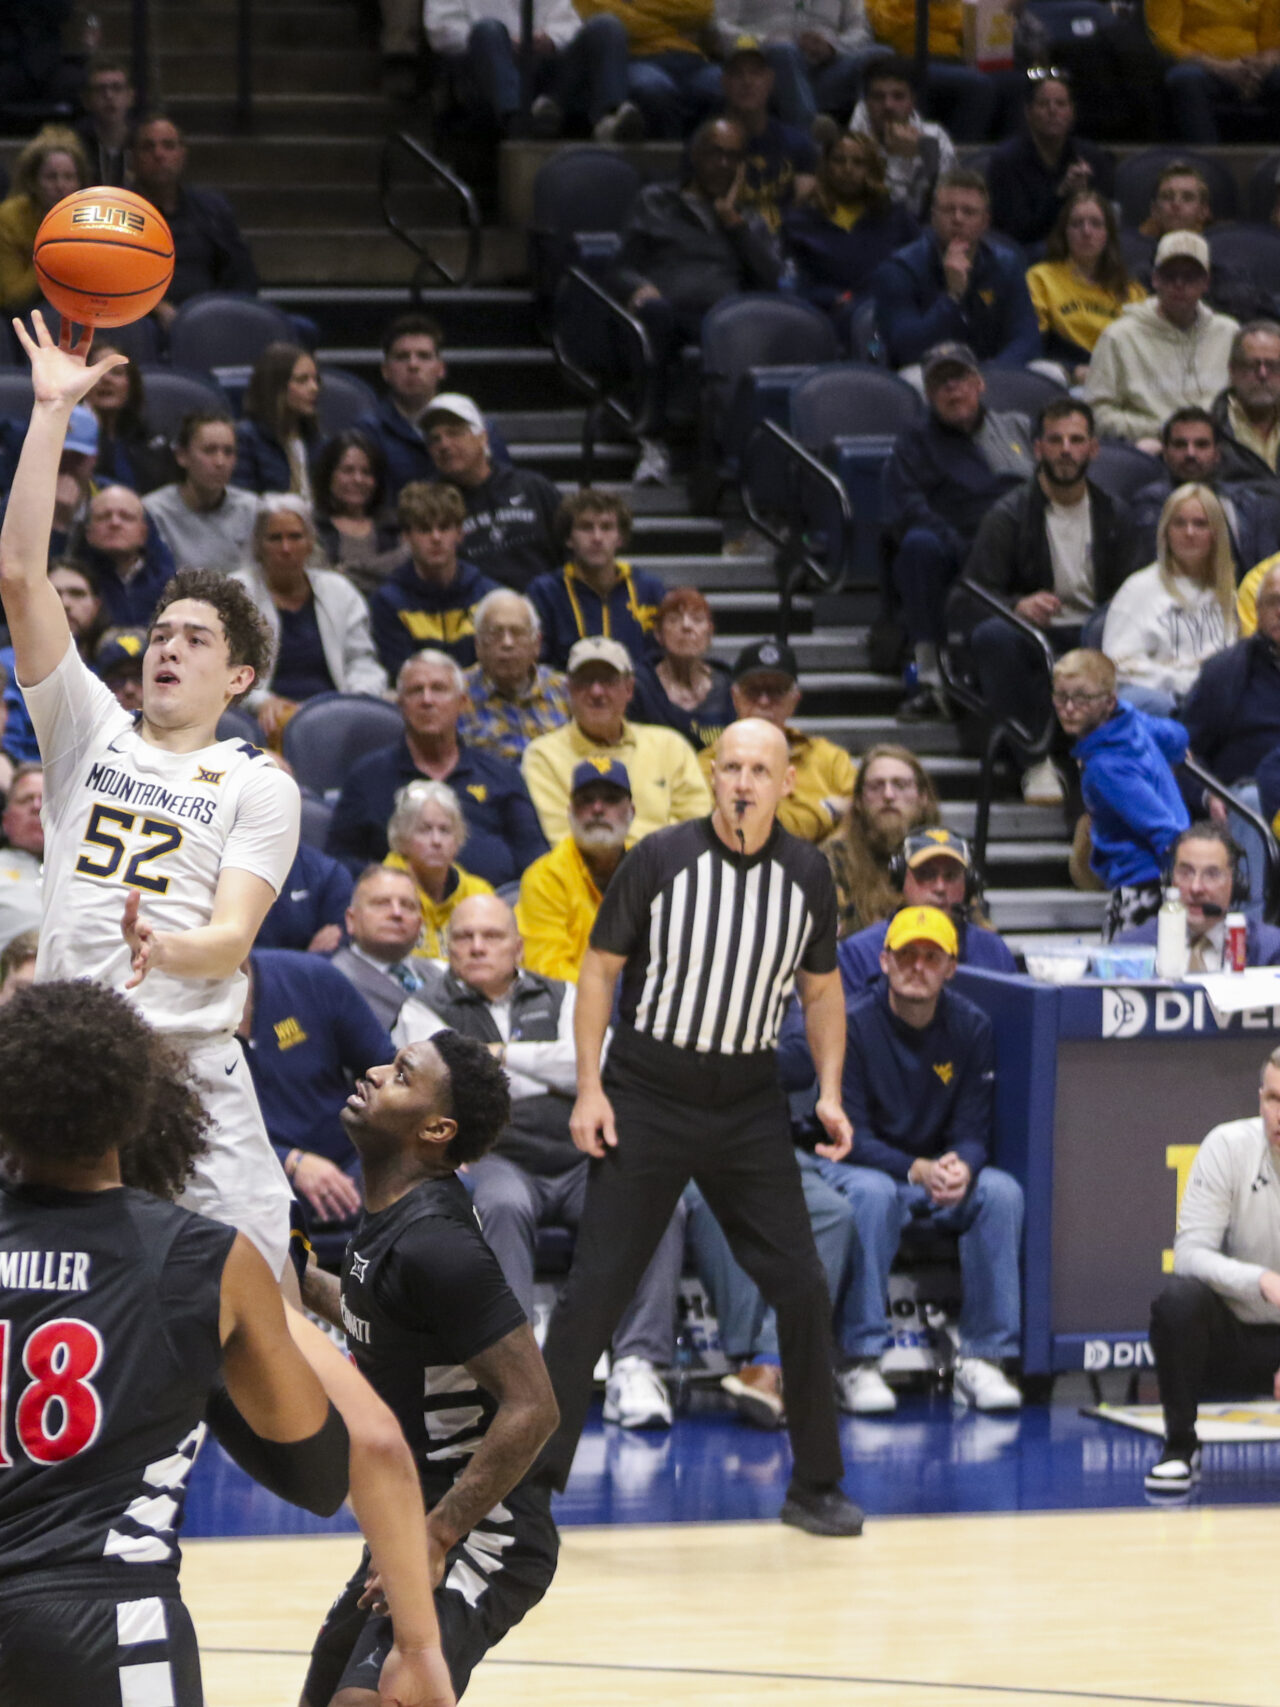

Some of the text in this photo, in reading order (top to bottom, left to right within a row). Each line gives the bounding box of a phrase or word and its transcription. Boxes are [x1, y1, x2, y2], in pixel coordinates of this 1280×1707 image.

[72, 206, 145, 232] ELITE
[85, 763, 217, 825] MOUNTAINEERS
[75, 802, 185, 896] 52
[1155, 990, 1280, 1031] DIVE
